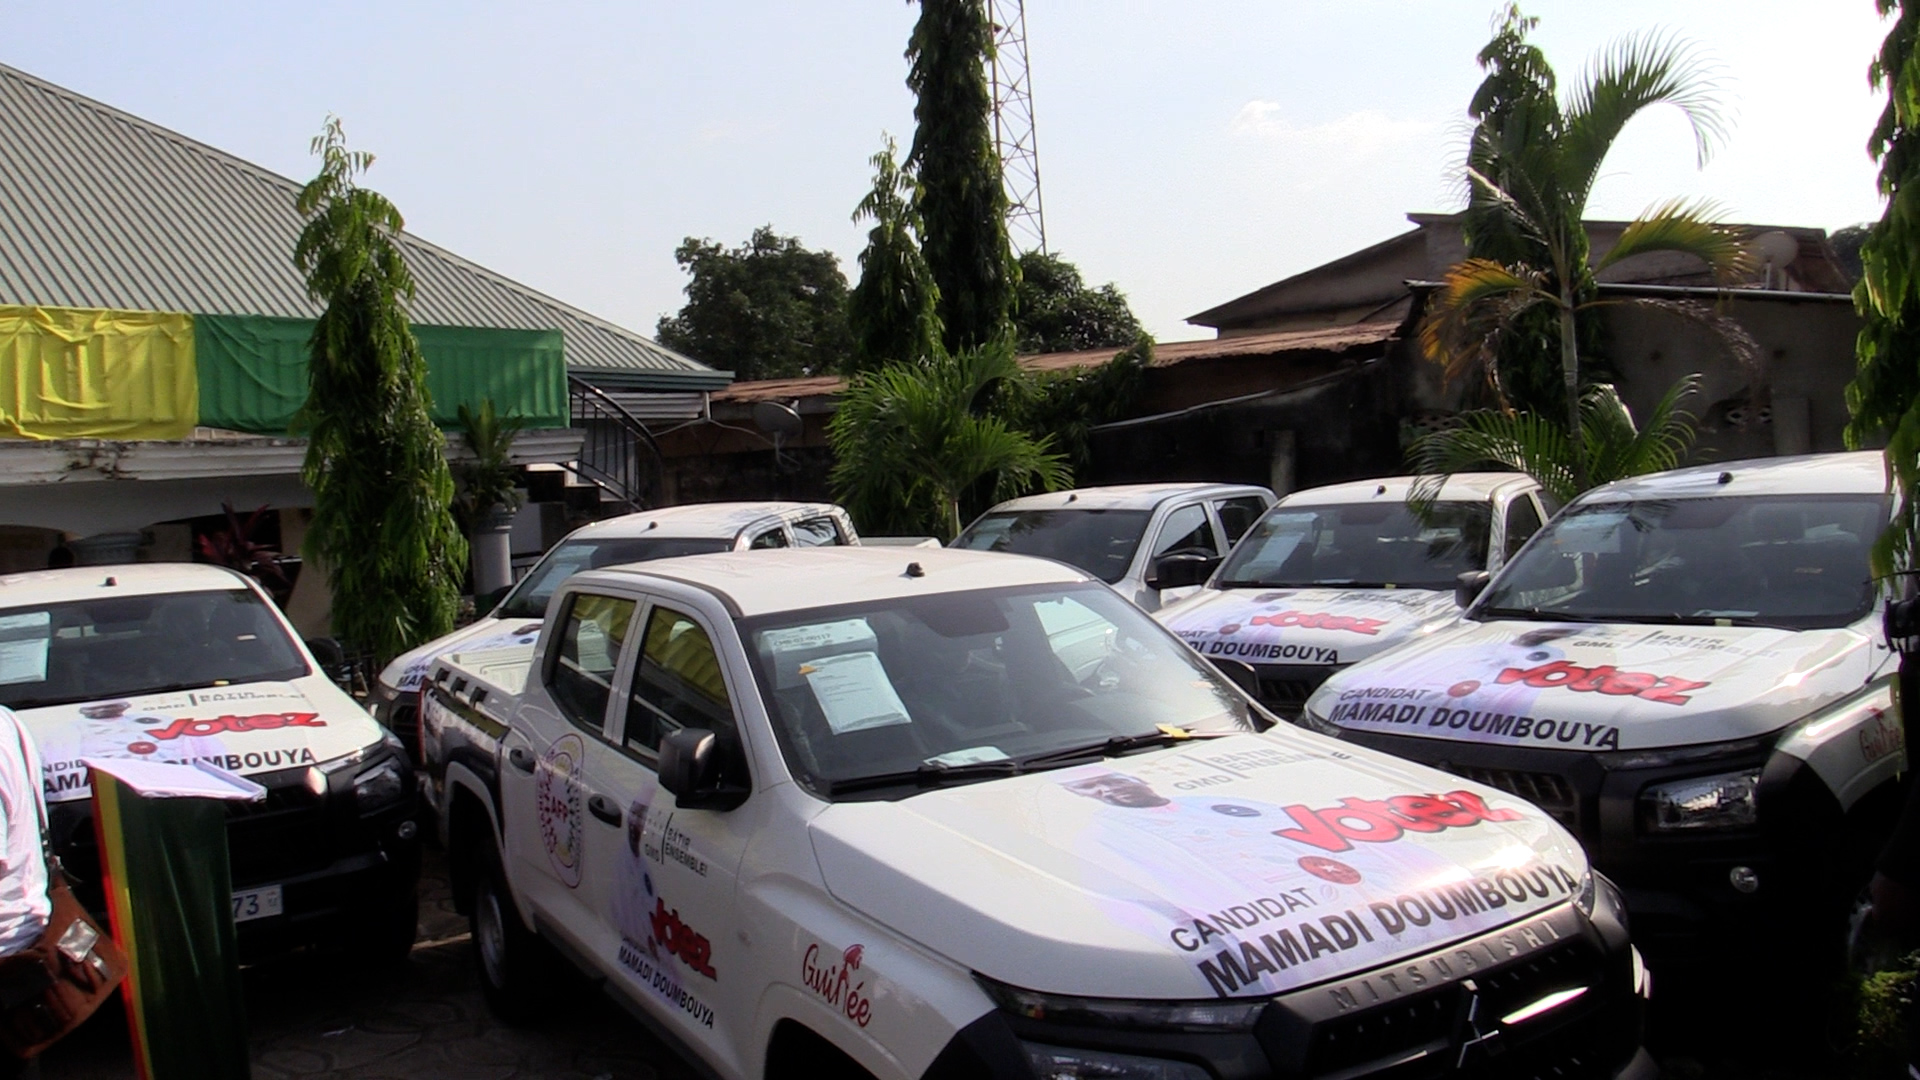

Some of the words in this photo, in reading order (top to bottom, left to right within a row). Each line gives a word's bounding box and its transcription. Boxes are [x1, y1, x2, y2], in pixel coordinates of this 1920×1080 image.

[1210, 641, 1339, 664] DOUMBOUYA
[1329, 701, 1425, 725] MAMADI
[1428, 707, 1620, 750] DOUMBOUYA
[1340, 687, 1431, 701] CANDIDAT
[1173, 774, 1233, 791] GMD
[1170, 887, 1318, 951] CANDIDAT
[1197, 909, 1375, 998] MAMADI
[1369, 863, 1577, 936] DOUMBOUYA
[618, 945, 653, 982] MAMADI
[652, 971, 715, 1030] DOUMBOUYA
[802, 943, 872, 1028] Guinée
[1328, 920, 1560, 1014] MITSUBISHI
